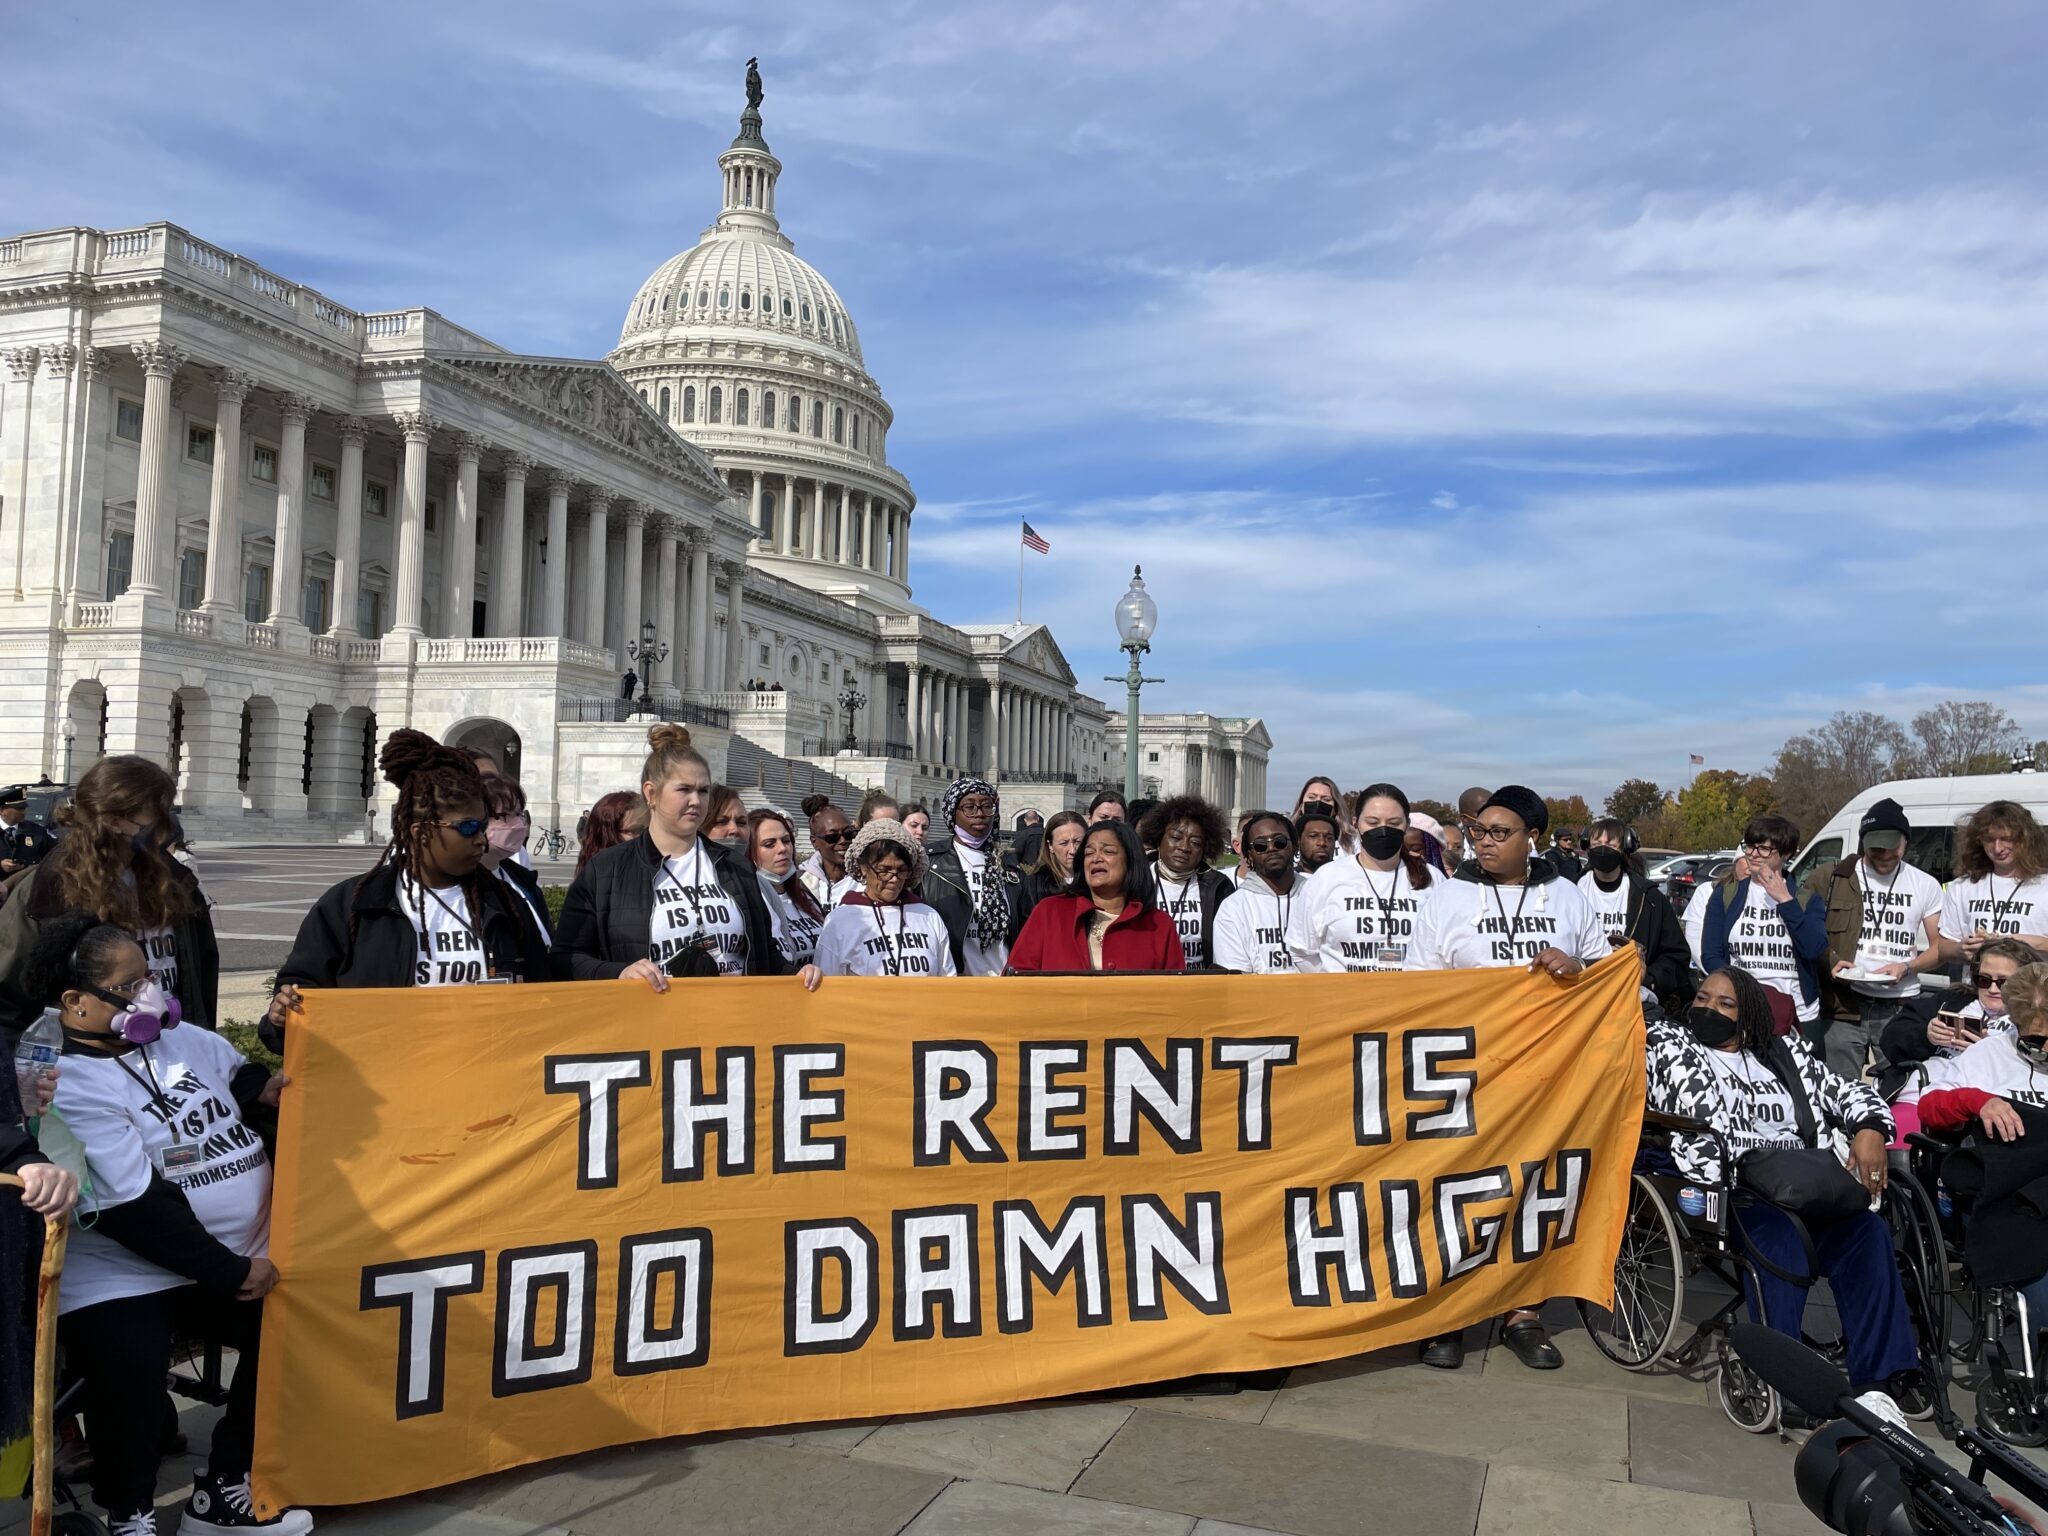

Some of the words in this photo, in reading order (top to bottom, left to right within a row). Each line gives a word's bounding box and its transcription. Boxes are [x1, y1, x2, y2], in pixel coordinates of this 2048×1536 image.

[655, 887, 683, 904] HE
[1344, 897, 1374, 911] THE
[1861, 890, 1875, 904] HE
[1170, 900, 1201, 913] REN
[1968, 899, 1992, 913] THE
[667, 908, 690, 929] IS
[1175, 919, 1200, 936] OO
[1357, 916, 1374, 935] IS
[1378, 917, 1412, 936] TOO
[1512, 917, 1556, 934] RENT
[1740, 922, 1755, 937] IS
[1758, 924, 1786, 938] TOO
[435, 930, 480, 952] REN
[863, 934, 894, 956] THE
[1269, 950, 1283, 968] IS
[1492, 941, 1513, 960] IS
[1768, 943, 1795, 959] HIG
[416, 960, 430, 985] S
[437, 960, 481, 984] TOO
[900, 955, 930, 973] TOO
[544, 1043, 846, 1190] THE
[912, 1036, 1299, 1167] RENT
[1353, 1026, 1478, 1146] IS
[181, 1109, 205, 1138] IS
[1708, 1193, 1717, 1220] 10
[359, 1227, 713, 1421] TOO
[784, 1191, 1231, 1357] DAMN
[1285, 1148, 1591, 1306] HIGH
[1890, 1431, 1926, 1458] SENNHEISER
